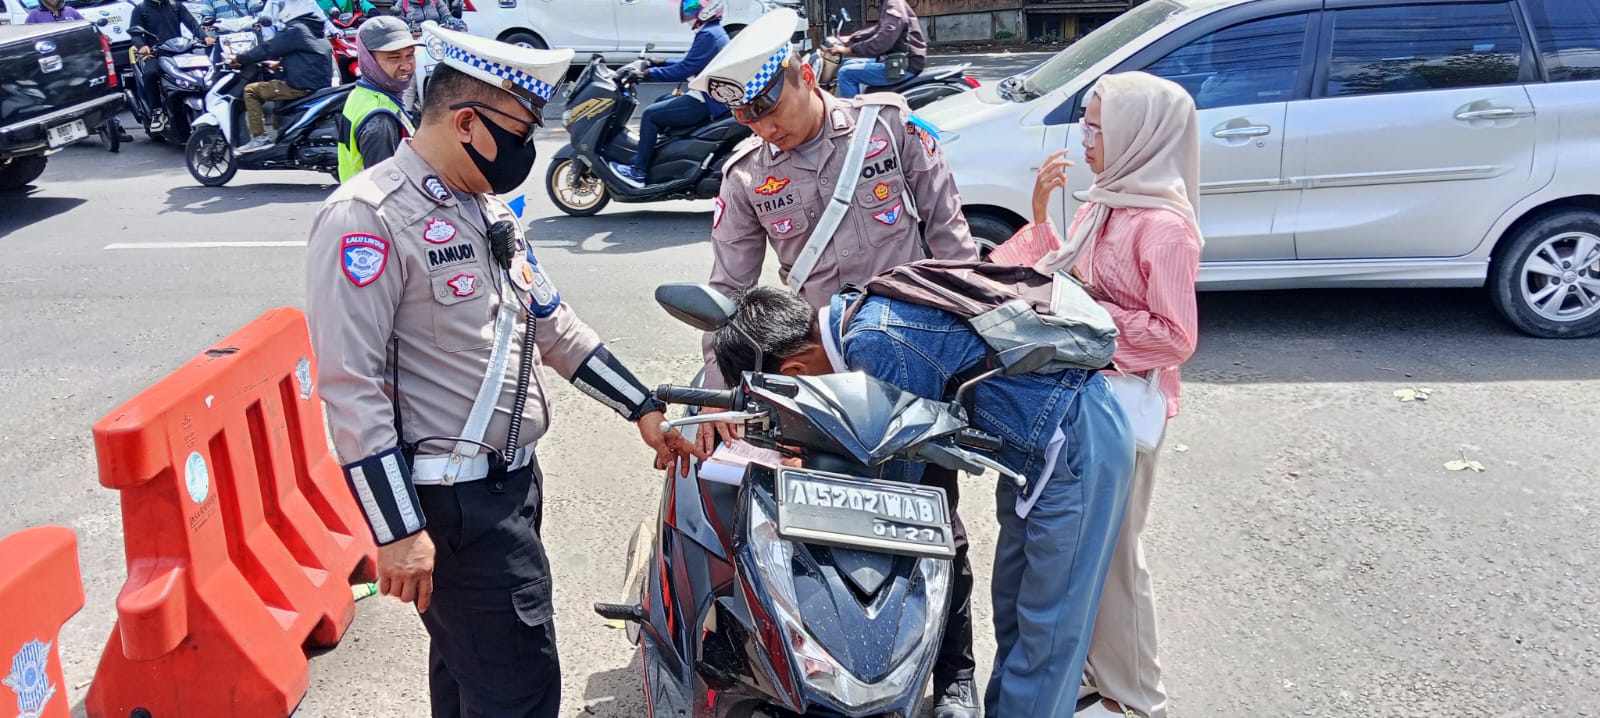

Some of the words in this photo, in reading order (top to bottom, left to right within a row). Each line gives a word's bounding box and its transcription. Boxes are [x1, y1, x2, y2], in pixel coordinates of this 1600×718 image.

[860, 156, 898, 179] OLRI
[757, 194, 794, 214] TRIAS
[346, 236, 363, 244] LALU
[428, 243, 475, 267] RAMUDI
[793, 483, 807, 505] A
[815, 486, 879, 514] 5202
[881, 493, 934, 523] WAB
